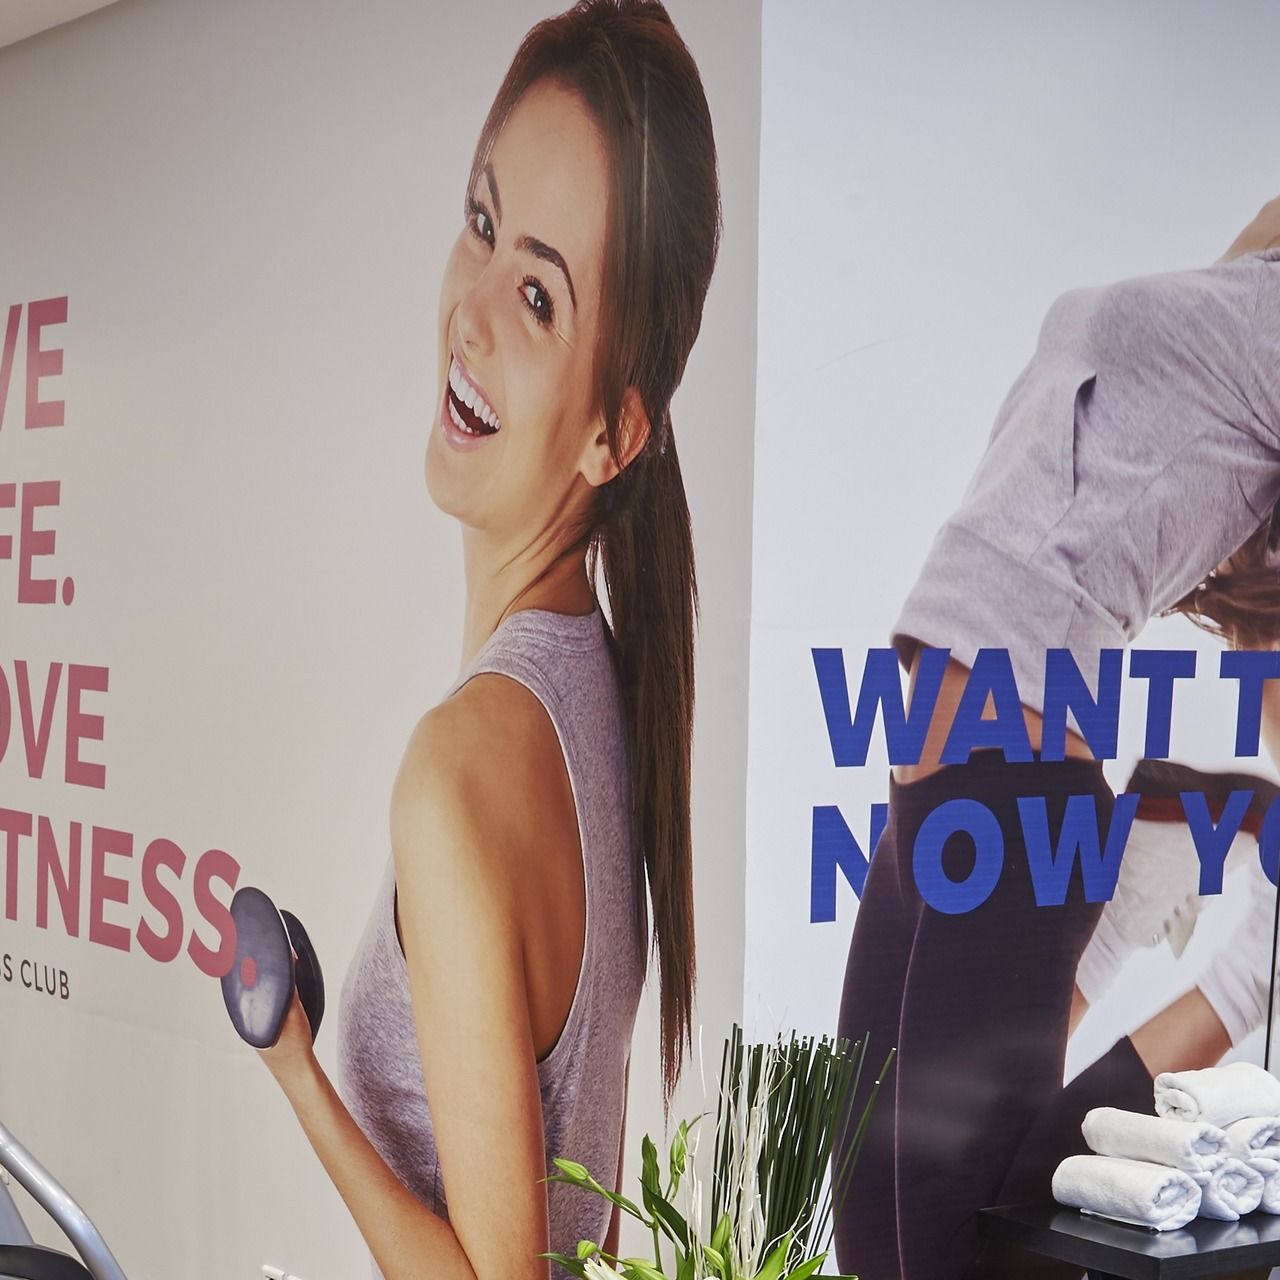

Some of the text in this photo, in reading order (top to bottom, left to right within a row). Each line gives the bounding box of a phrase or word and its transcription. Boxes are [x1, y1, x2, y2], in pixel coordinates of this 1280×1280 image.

[811, 648, 1197, 768] WANT
[810, 793, 1141, 924] NOW
[20, 959, 71, 1000] CLUB
